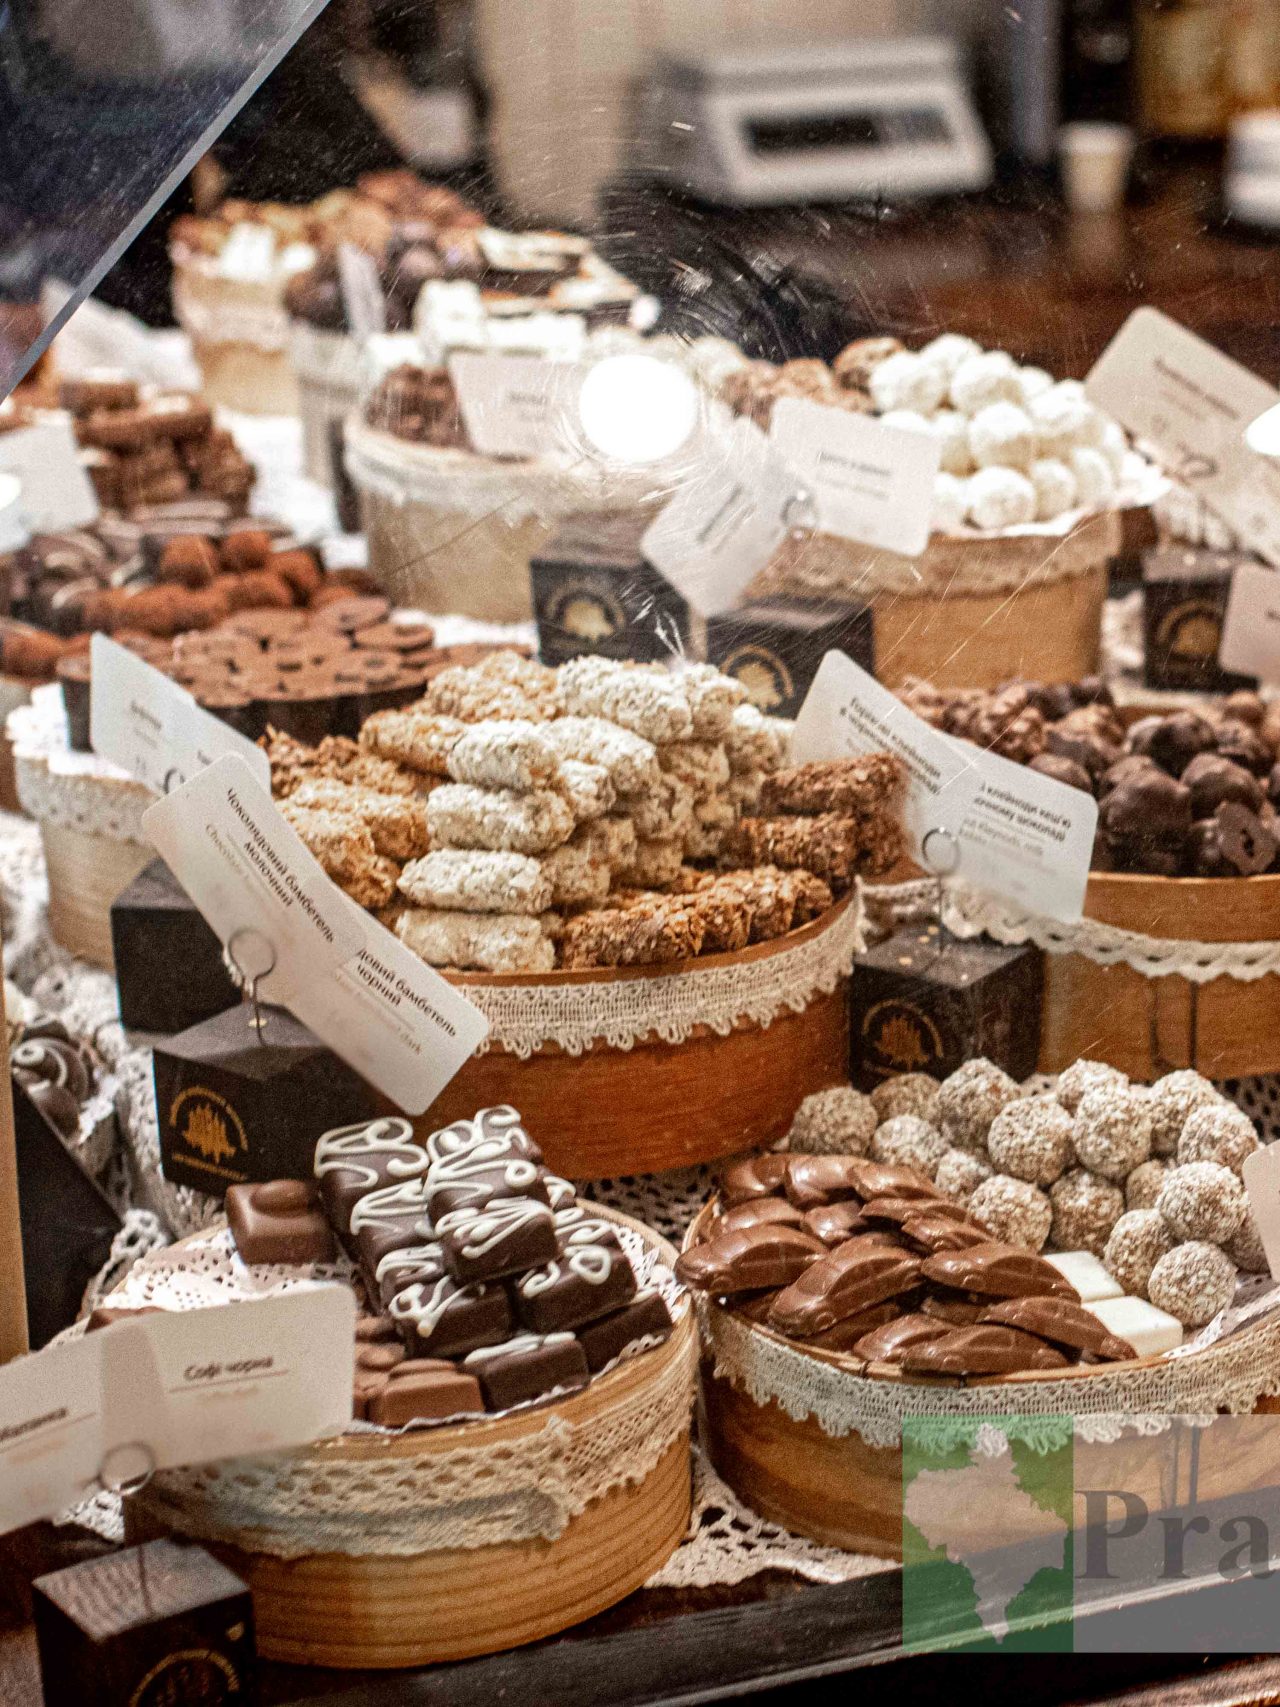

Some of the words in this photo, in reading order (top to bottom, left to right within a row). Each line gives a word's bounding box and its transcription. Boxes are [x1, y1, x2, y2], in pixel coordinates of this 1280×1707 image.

[243, 841, 294, 907] молочний
[284, 873, 335, 943] бамбетель
[356, 963, 402, 1006] чорний
[395, 978, 457, 1037] бамбетель
